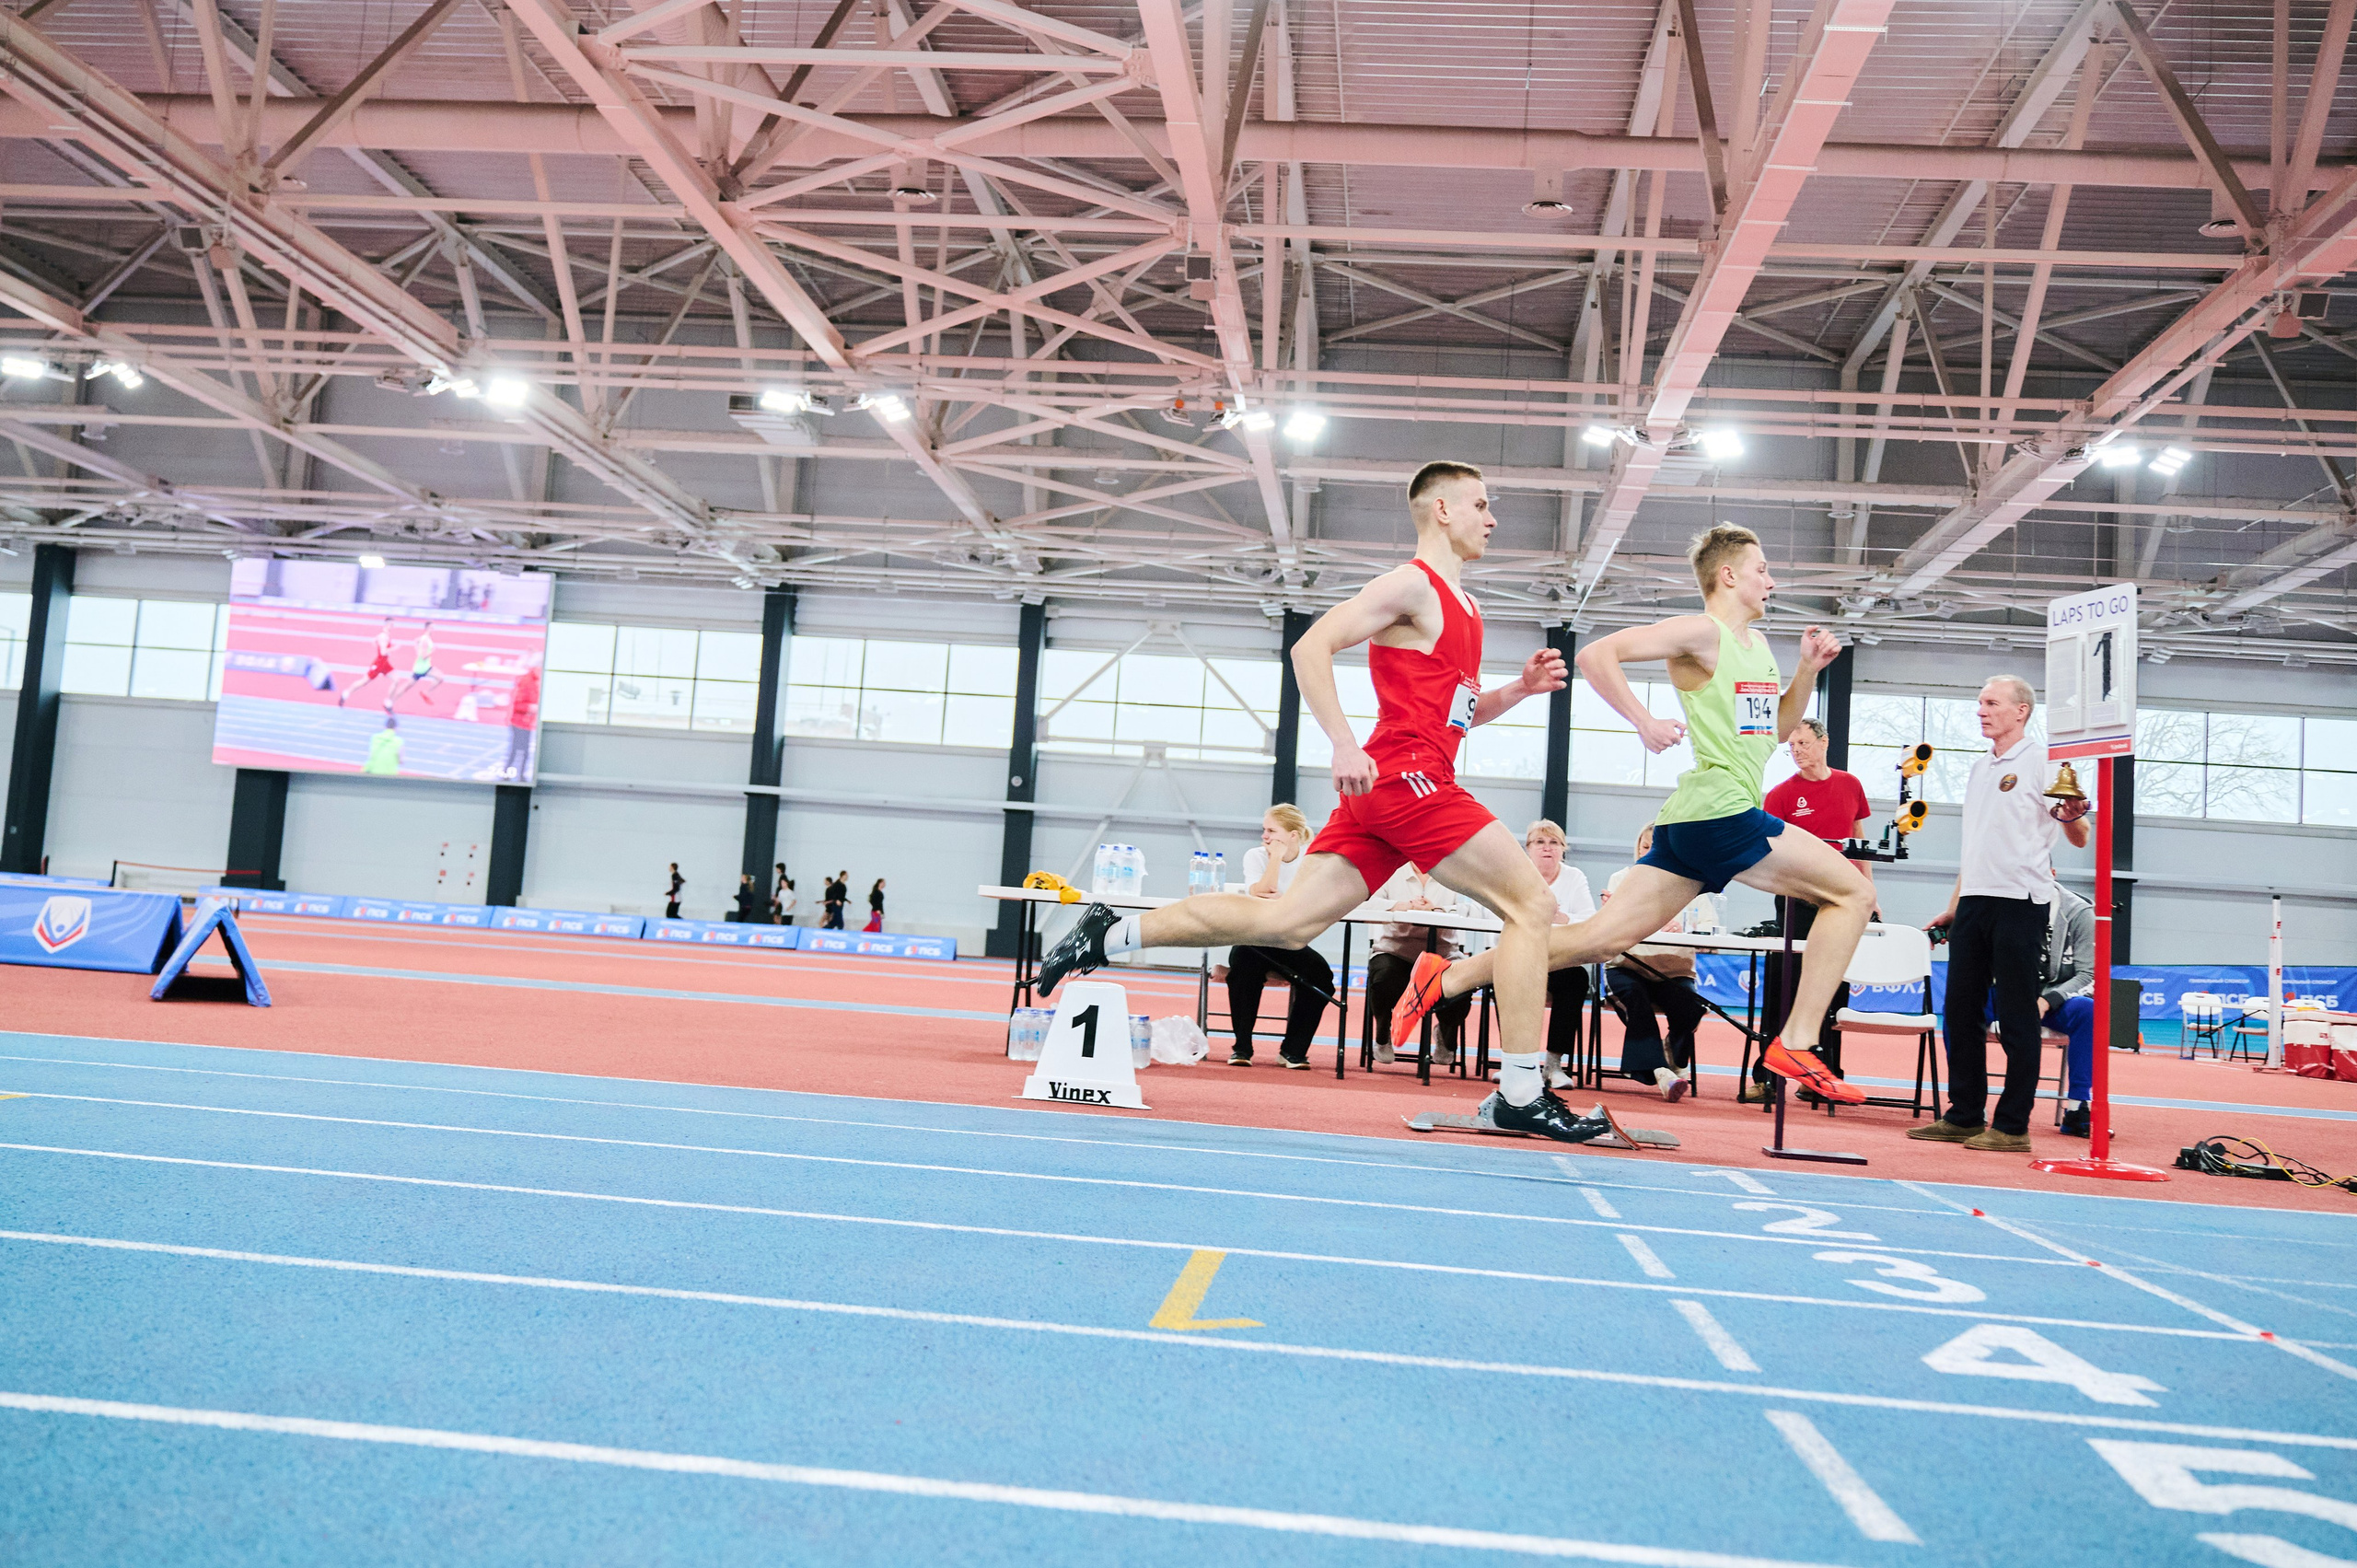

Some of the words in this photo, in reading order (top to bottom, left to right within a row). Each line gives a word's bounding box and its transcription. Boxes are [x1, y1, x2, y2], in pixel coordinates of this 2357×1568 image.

[2052, 605, 2083, 626] LAPS
[2087, 600, 2105, 619] TO
[2109, 595, 2129, 614] GO
[2093, 632, 2112, 702] 1
[1746, 697, 1771, 718] 194
[2139, 993, 2165, 1005] СБ
[1072, 1005, 1099, 1058] 1
[1049, 1081, 1111, 1104] Vinex
[1732, 1202, 1882, 1241] 2
[1813, 1251, 1987, 1304] 3
[1922, 1324, 2169, 1408] 4
